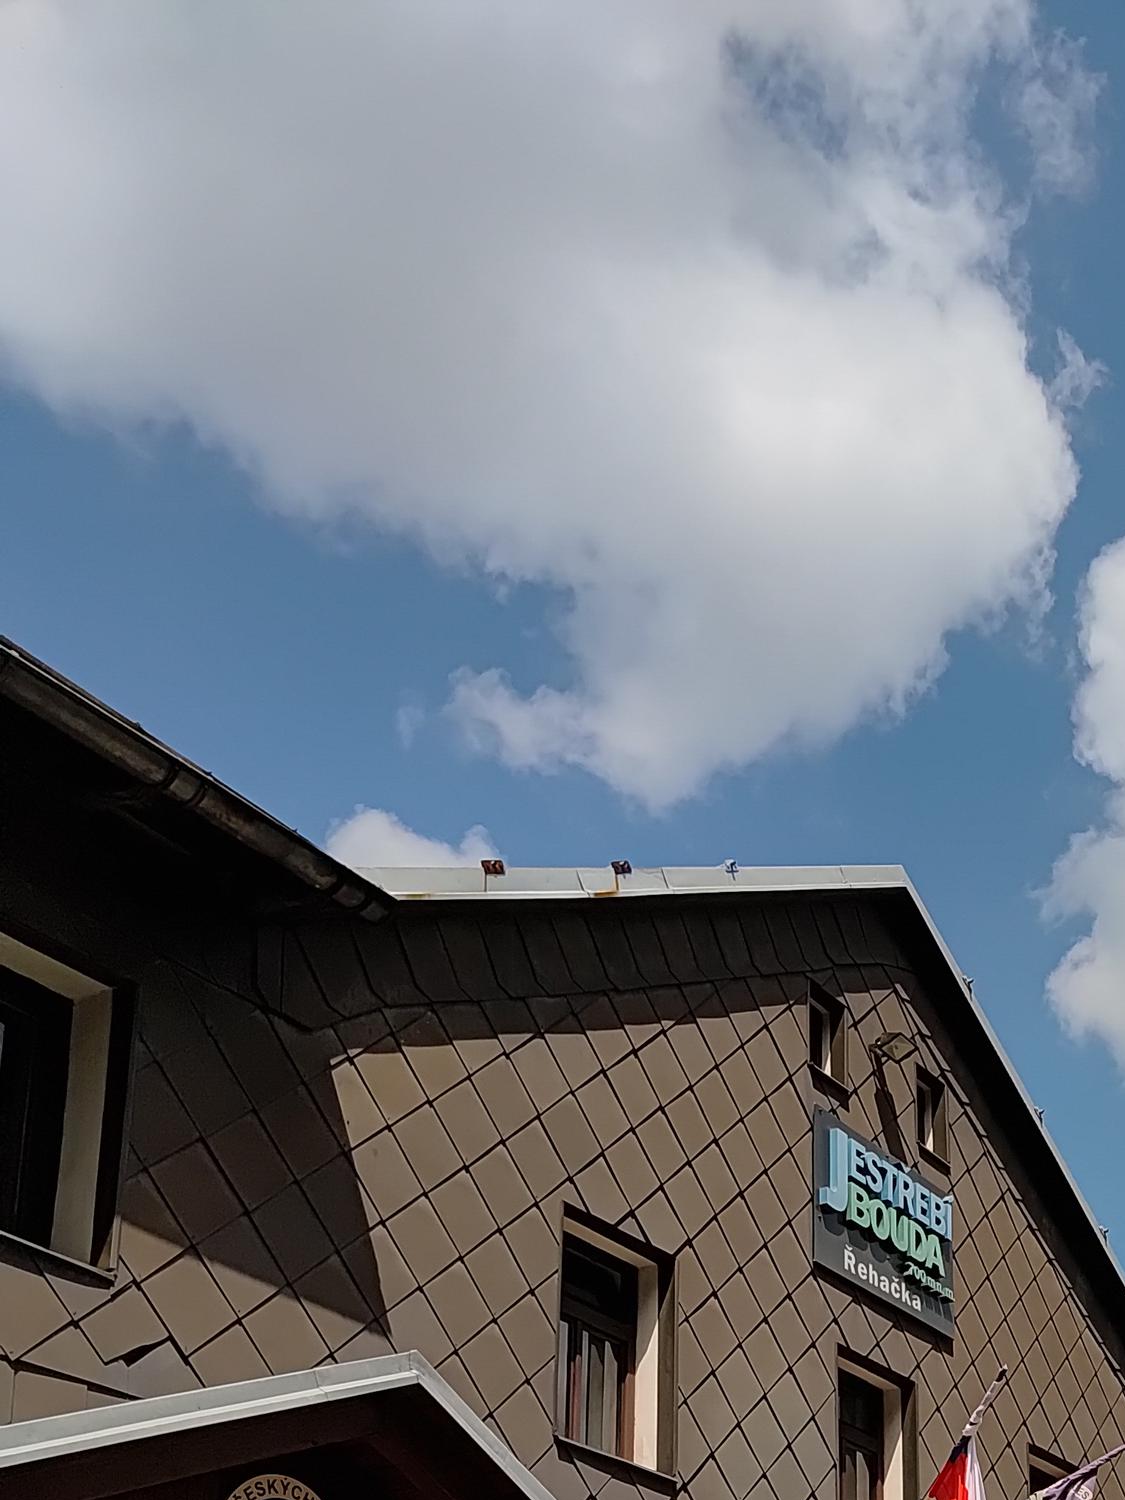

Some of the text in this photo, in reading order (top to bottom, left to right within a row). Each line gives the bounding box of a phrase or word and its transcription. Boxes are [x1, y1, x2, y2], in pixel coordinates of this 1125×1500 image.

[819, 1127, 953, 1242] JESTŘEBÍ
[846, 1182, 946, 1277] BOUDA
[844, 1244, 922, 1312] Řehačka
